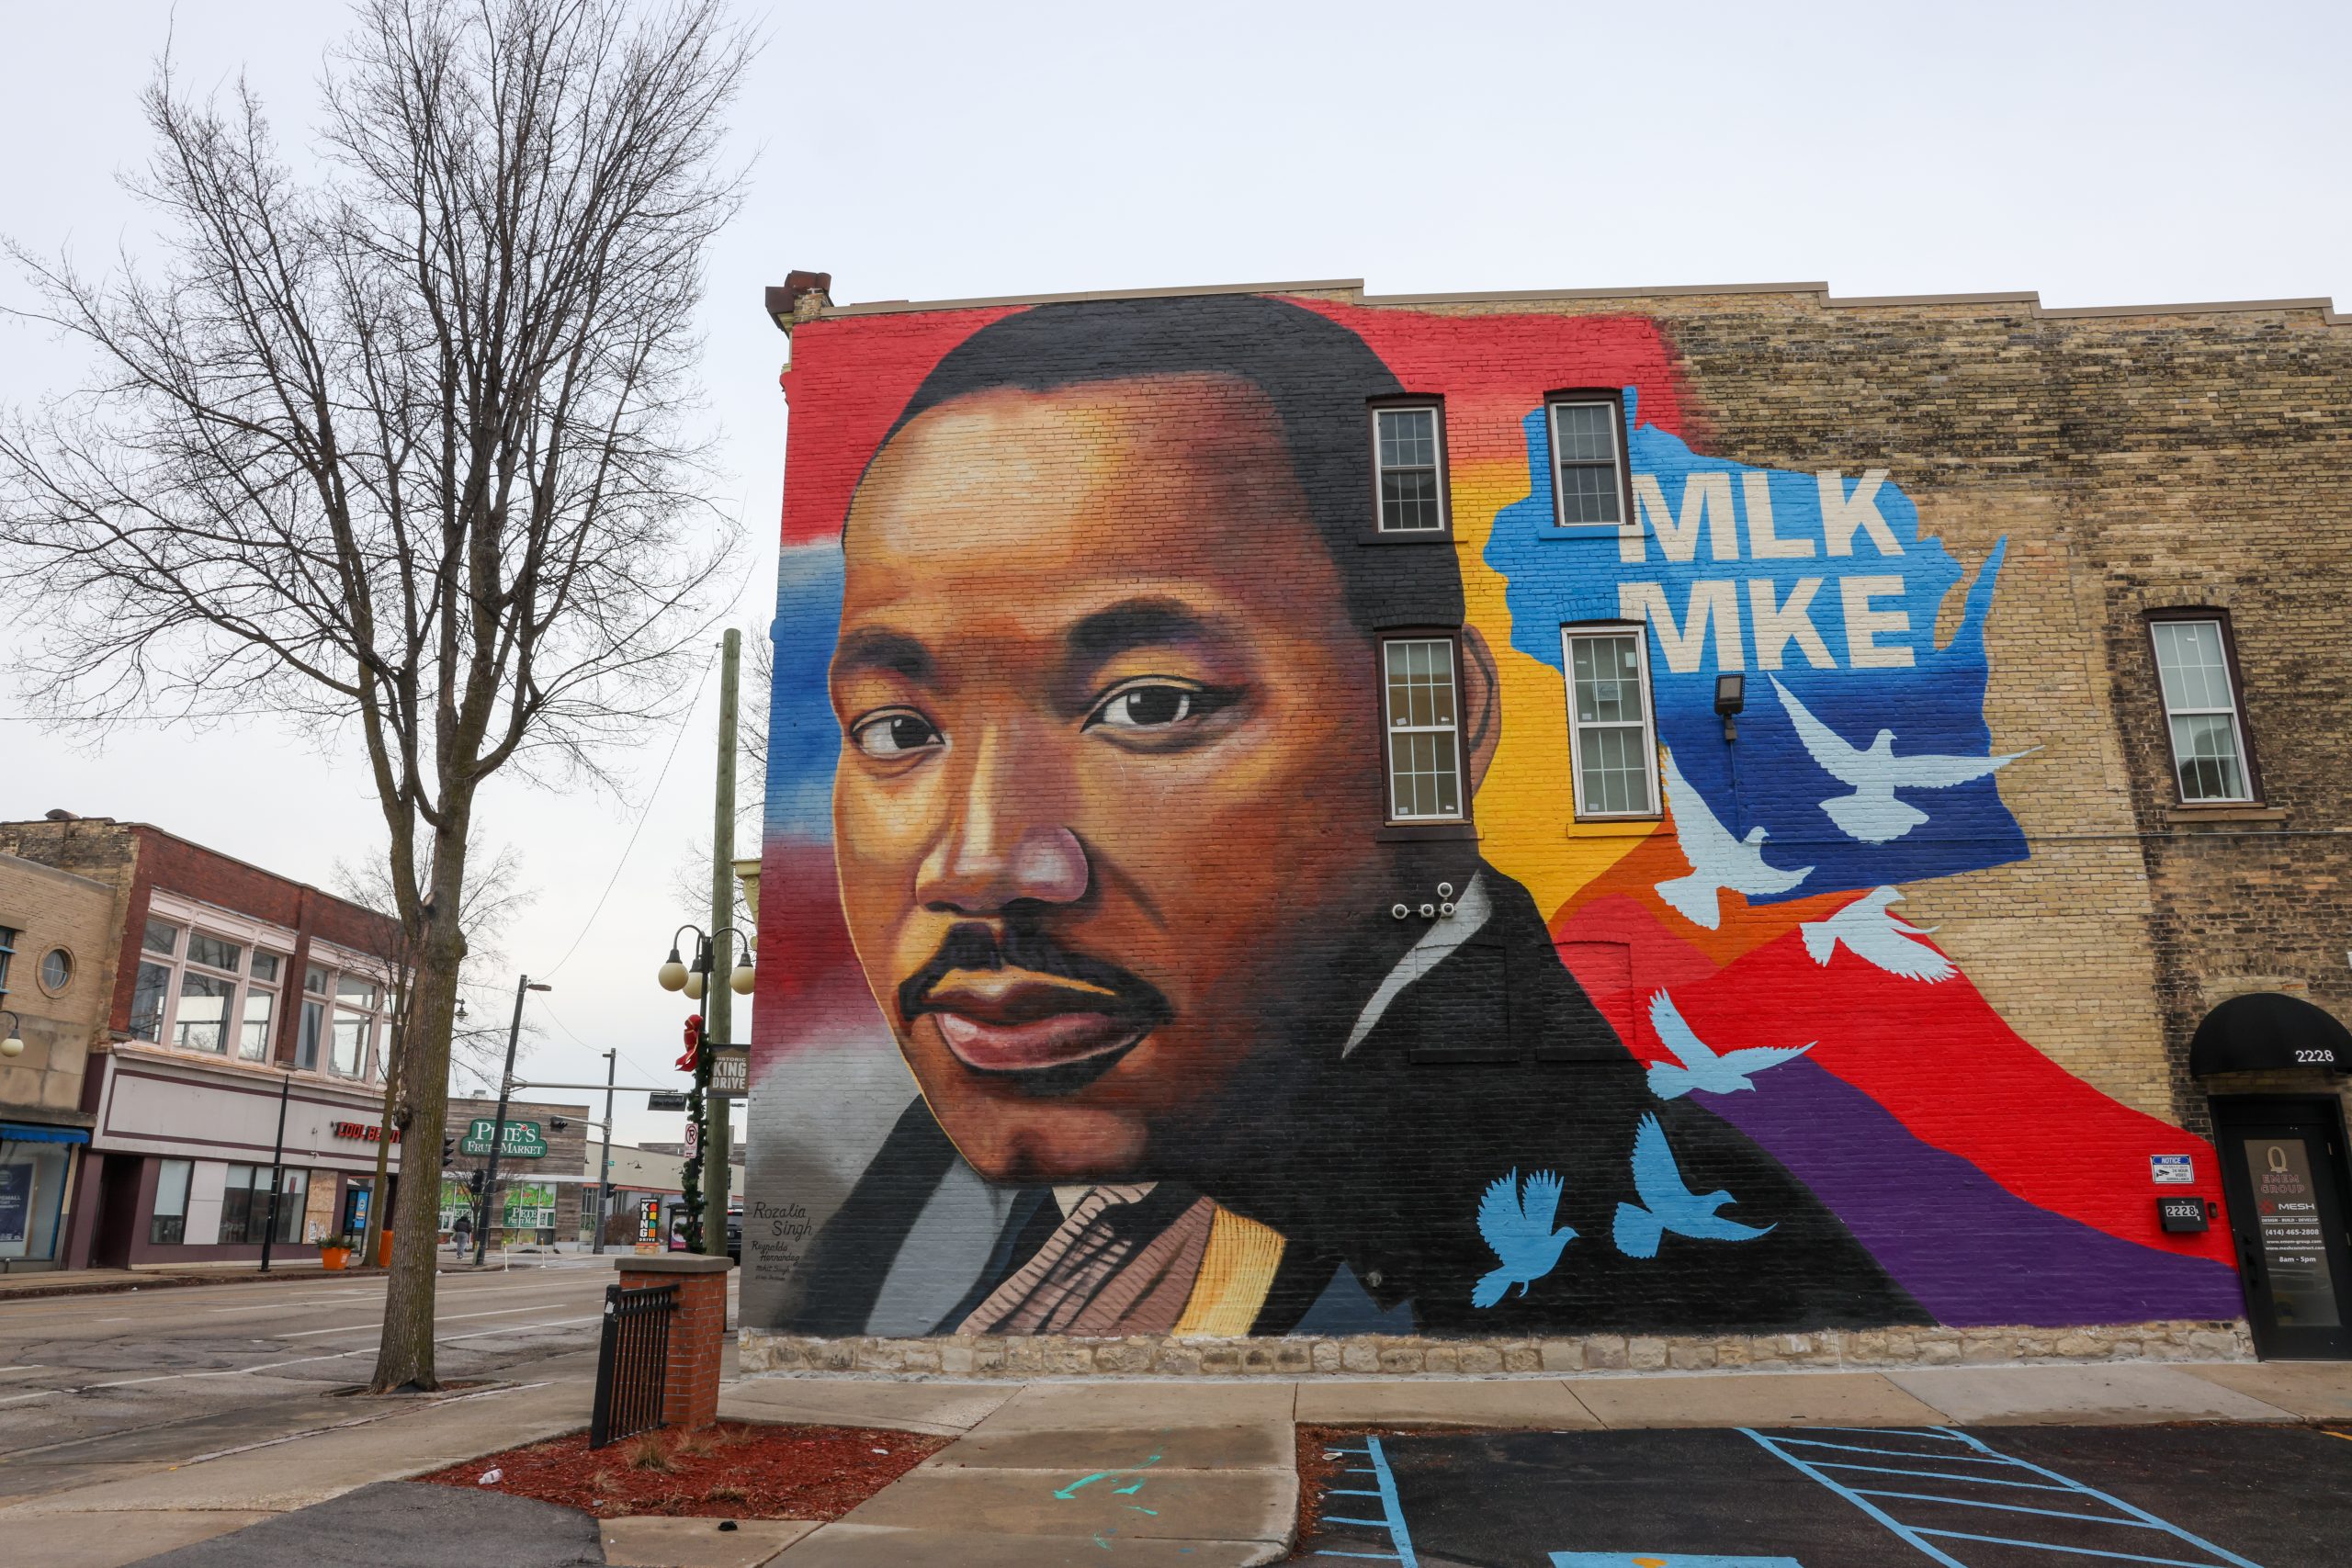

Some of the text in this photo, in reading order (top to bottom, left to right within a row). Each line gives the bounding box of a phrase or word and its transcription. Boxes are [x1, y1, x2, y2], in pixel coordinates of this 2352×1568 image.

[1618, 468, 1906, 564] MLK
[1617, 574, 1917, 674] MKE
[2295, 1050, 2335, 1063] 2228
[713, 1061, 747, 1077] KING
[712, 1077, 746, 1089] DRIVE
[337, 1122, 366, 1140] COOL
[501, 1142, 543, 1155] MARKET
[2161, 1156, 2182, 1165] NOTICE
[2262, 1174, 2300, 1184] EMEM
[2261, 1184, 2305, 1194] GROUP
[753, 1201, 807, 1219] Rozalia
[2166, 1205, 2196, 1216] 2228
[2278, 1202, 2315, 1211] MESH
[639, 1202, 650, 1238] KING
[772, 1217, 813, 1243] Singh
[752, 1240, 788, 1254] Reynaldo
[2300, 1256, 2316, 1264] 5pm
